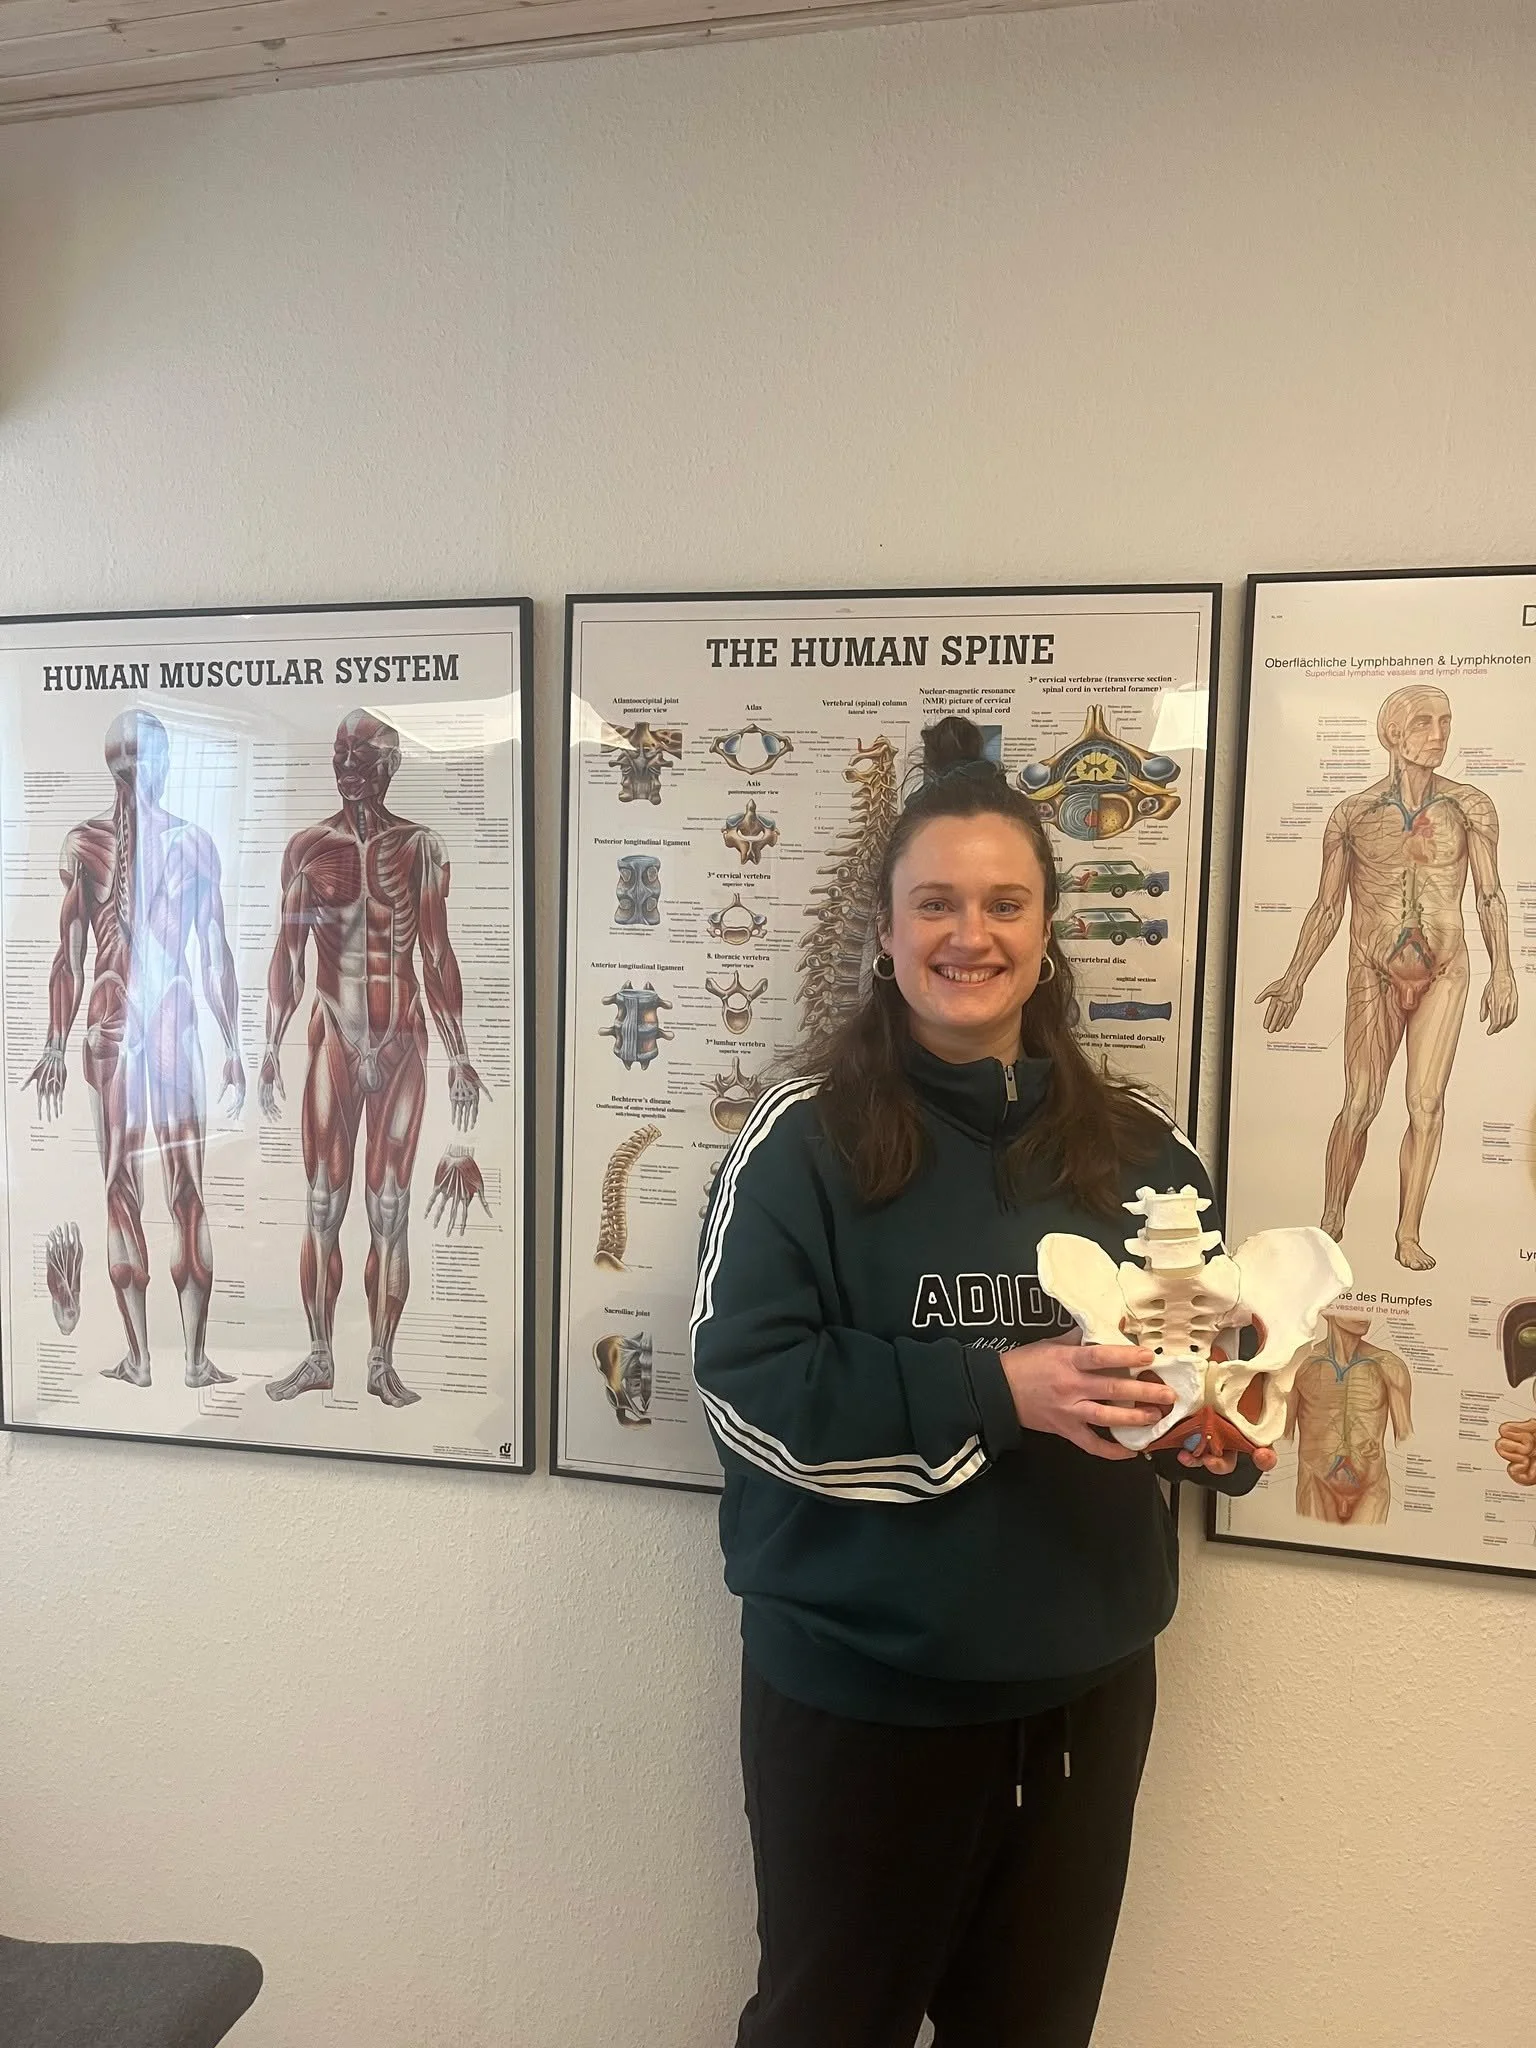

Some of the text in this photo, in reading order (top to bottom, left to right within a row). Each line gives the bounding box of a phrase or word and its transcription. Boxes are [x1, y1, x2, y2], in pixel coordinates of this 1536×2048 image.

[706, 634, 1055, 668] THE HUMAN SPINE
[1264, 654, 1532, 669] Oberflächliche Lymphbahnen & Lymphknoten
[43, 653, 460, 692] HUMAN MUSCULAR SYSTEM
[1305, 669, 1346, 678] Superficial
[1347, 669, 1385, 678] lymphatic
[1435, 667, 1461, 677] lymph
[1462, 667, 1488, 675] nodes
[1104, 675, 1146, 683] (transverse
[919, 687, 979, 695] Nuclear-magnetic
[1042, 686, 1064, 694] spinal
[1128, 685, 1162, 693] foramen)
[664, 697, 679, 705] joint
[822, 699, 854, 707] Vertebral
[855, 699, 881, 708] (spinal)
[922, 697, 947, 705] (NMR)
[949, 697, 972, 705] picture
[972, 707, 993, 715] spinal
[623, 838, 662, 847] longitudinal
[663, 839, 691, 847] ligament
[743, 872, 771, 880] vertebra
[618, 962, 656, 970] longitudinal
[657, 963, 684, 971] ligament
[1100, 1033, 1135, 1041] herniated
[1137, 1034, 1165, 1043] dorsally
[611, 1095, 671, 1105] Bechterew's disease
[912, 1273, 1074, 1328] ADID
[1356, 1291, 1377, 1302] des
[1381, 1293, 1433, 1307] Rumpfes
[604, 1307, 651, 1317] Sacroiliac joint
[1336, 1303, 1364, 1312] vessels
[1375, 1306, 1389, 1314] the
[1390, 1307, 1410, 1316] trunk
